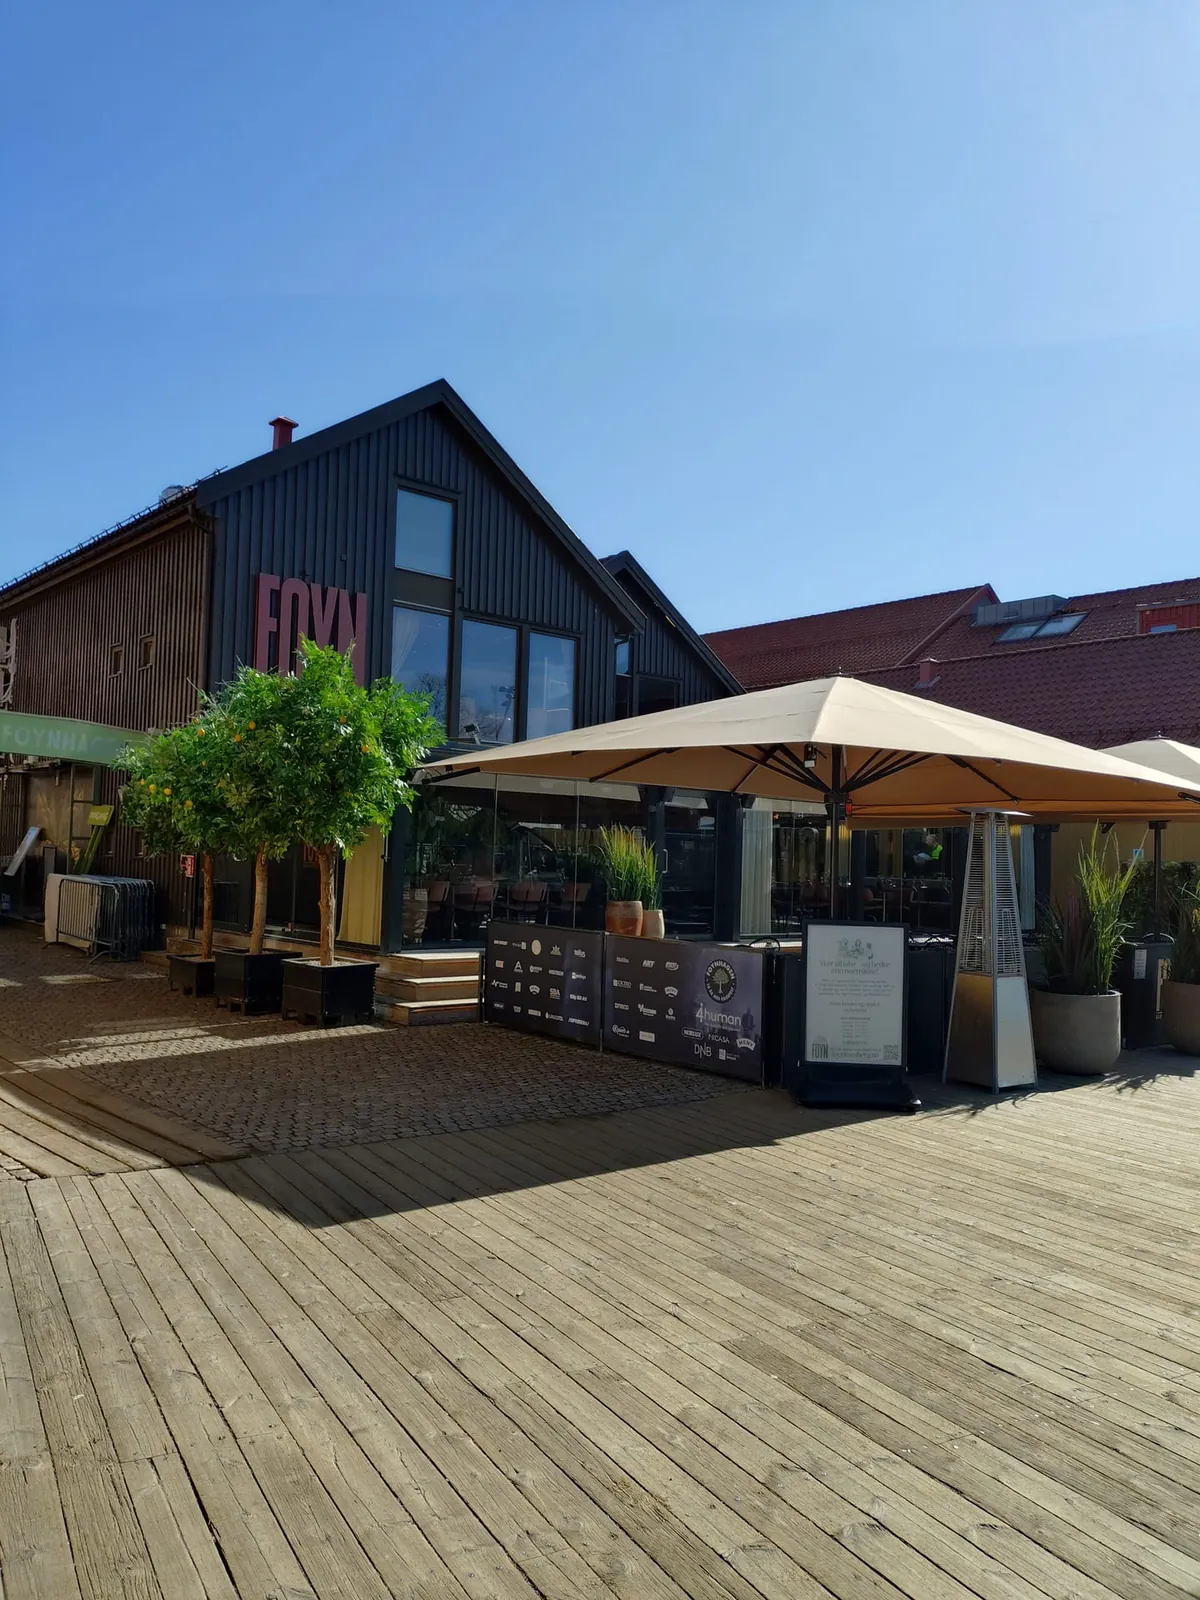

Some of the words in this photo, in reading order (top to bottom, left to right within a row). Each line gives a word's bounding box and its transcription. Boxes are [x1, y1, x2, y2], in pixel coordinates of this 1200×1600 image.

[695, 1002, 742, 1027] 4human
[694, 1042, 712, 1059] DNB
[811, 1043, 829, 1059] FOYN
